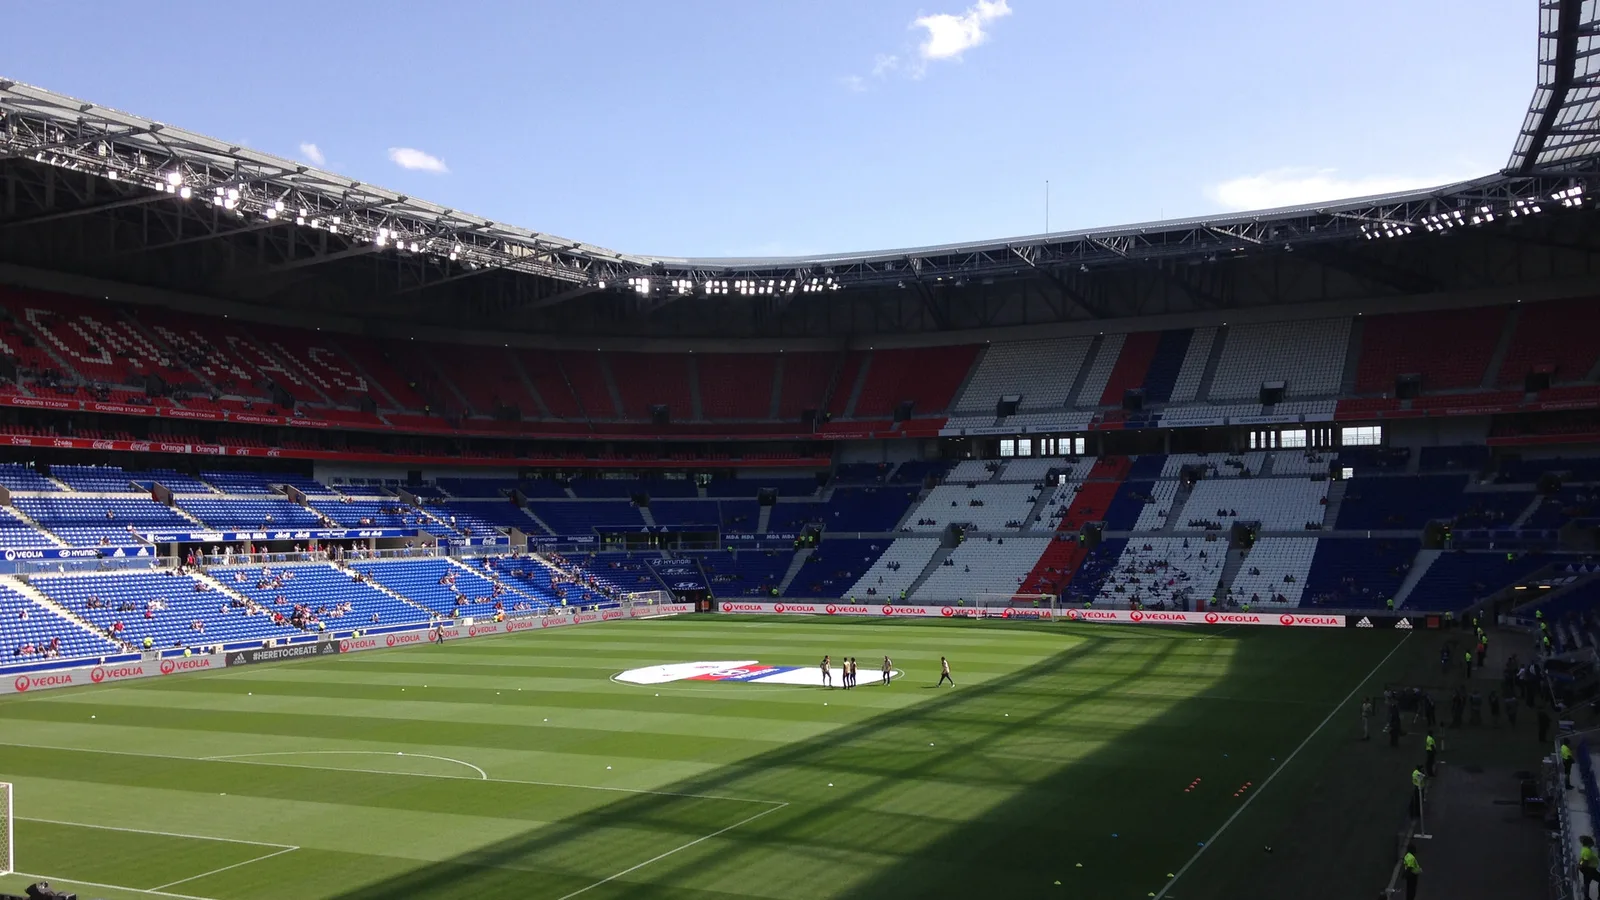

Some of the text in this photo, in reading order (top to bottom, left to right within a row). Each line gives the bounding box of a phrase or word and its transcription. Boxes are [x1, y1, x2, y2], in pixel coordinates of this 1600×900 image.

[12, 397, 44, 406] Groupama
[95, 403, 124, 412] Groupama
[170, 409, 196, 418] Groupama
[160, 444, 184, 452] Orange
[196, 445, 218, 454] Orange
[16, 550, 44, 559] VEOLIA
[1220, 615, 1260, 623] VEOLIA
[1296, 616, 1338, 624] VEOLIA
[394, 634, 421, 644] VEOLIA
[350, 639, 376, 649] VEOLIA
[252, 646, 317, 660] #HERETOCREATE
[177, 659, 210, 670] VEOLIA
[106, 666, 144, 678] VEOLIA
[32, 674, 72, 686] VEOLIA
